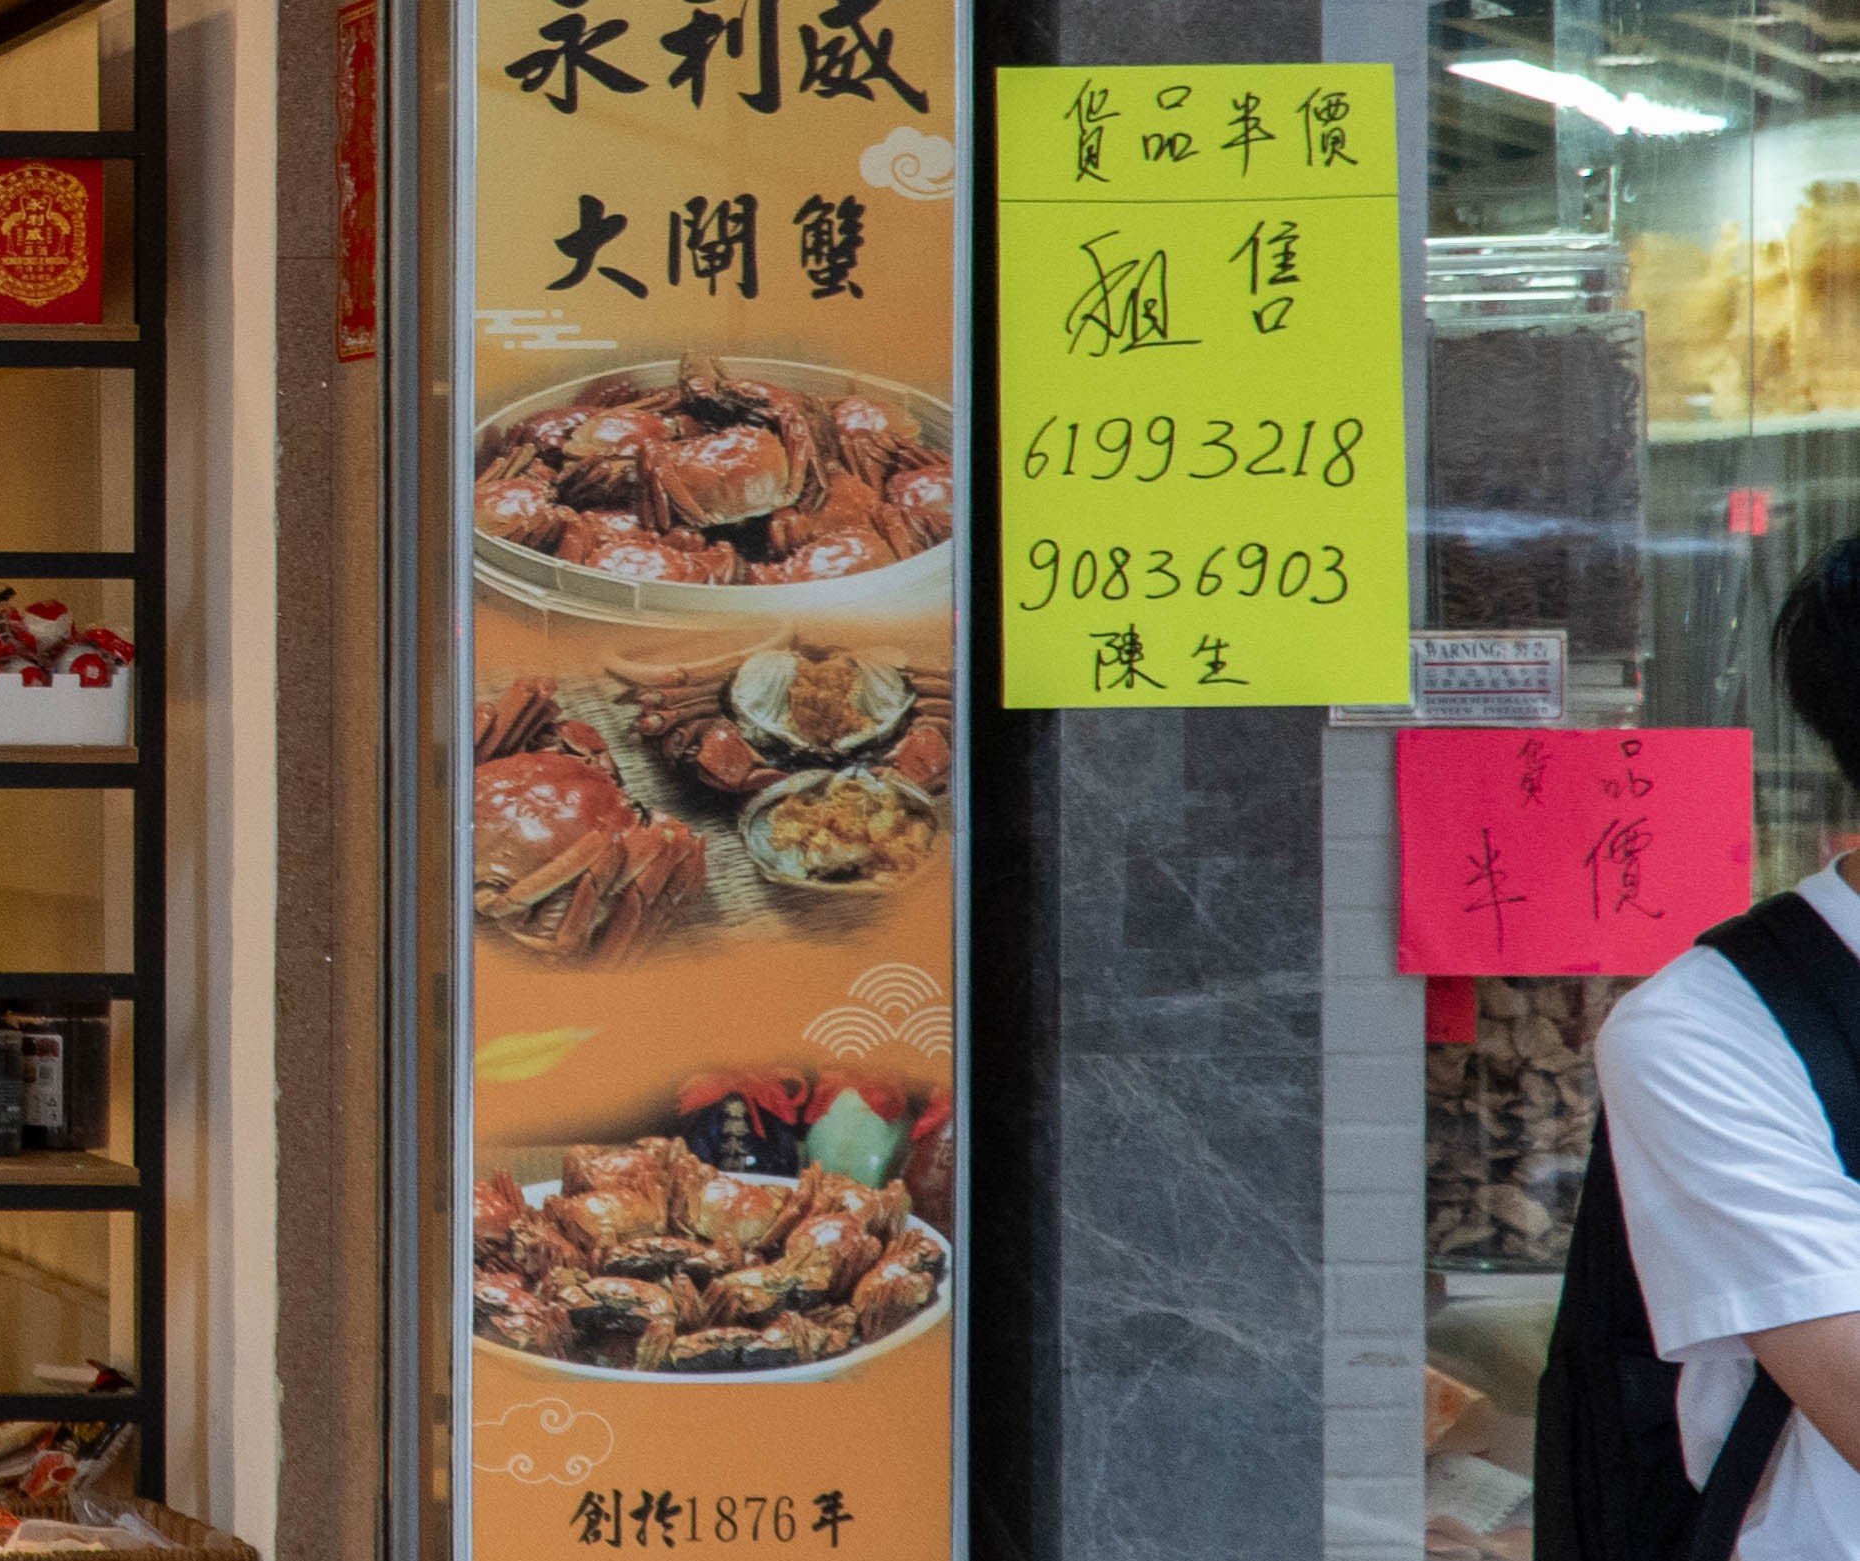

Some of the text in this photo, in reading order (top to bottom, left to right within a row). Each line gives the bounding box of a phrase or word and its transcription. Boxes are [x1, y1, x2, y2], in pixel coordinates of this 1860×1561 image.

[1066, 79, 1359, 182] 貨品半價
[546, 193, 865, 301] 大閘蟹
[1065, 220, 1302, 357] 租售
[1024, 416, 1364, 487] 61993218
[1019, 539, 1349, 611] 90836903
[1089, 623, 1250, 692] 陳生
[1517, 737, 1653, 807] 貨品
[1463, 816, 1665, 953] 半價
